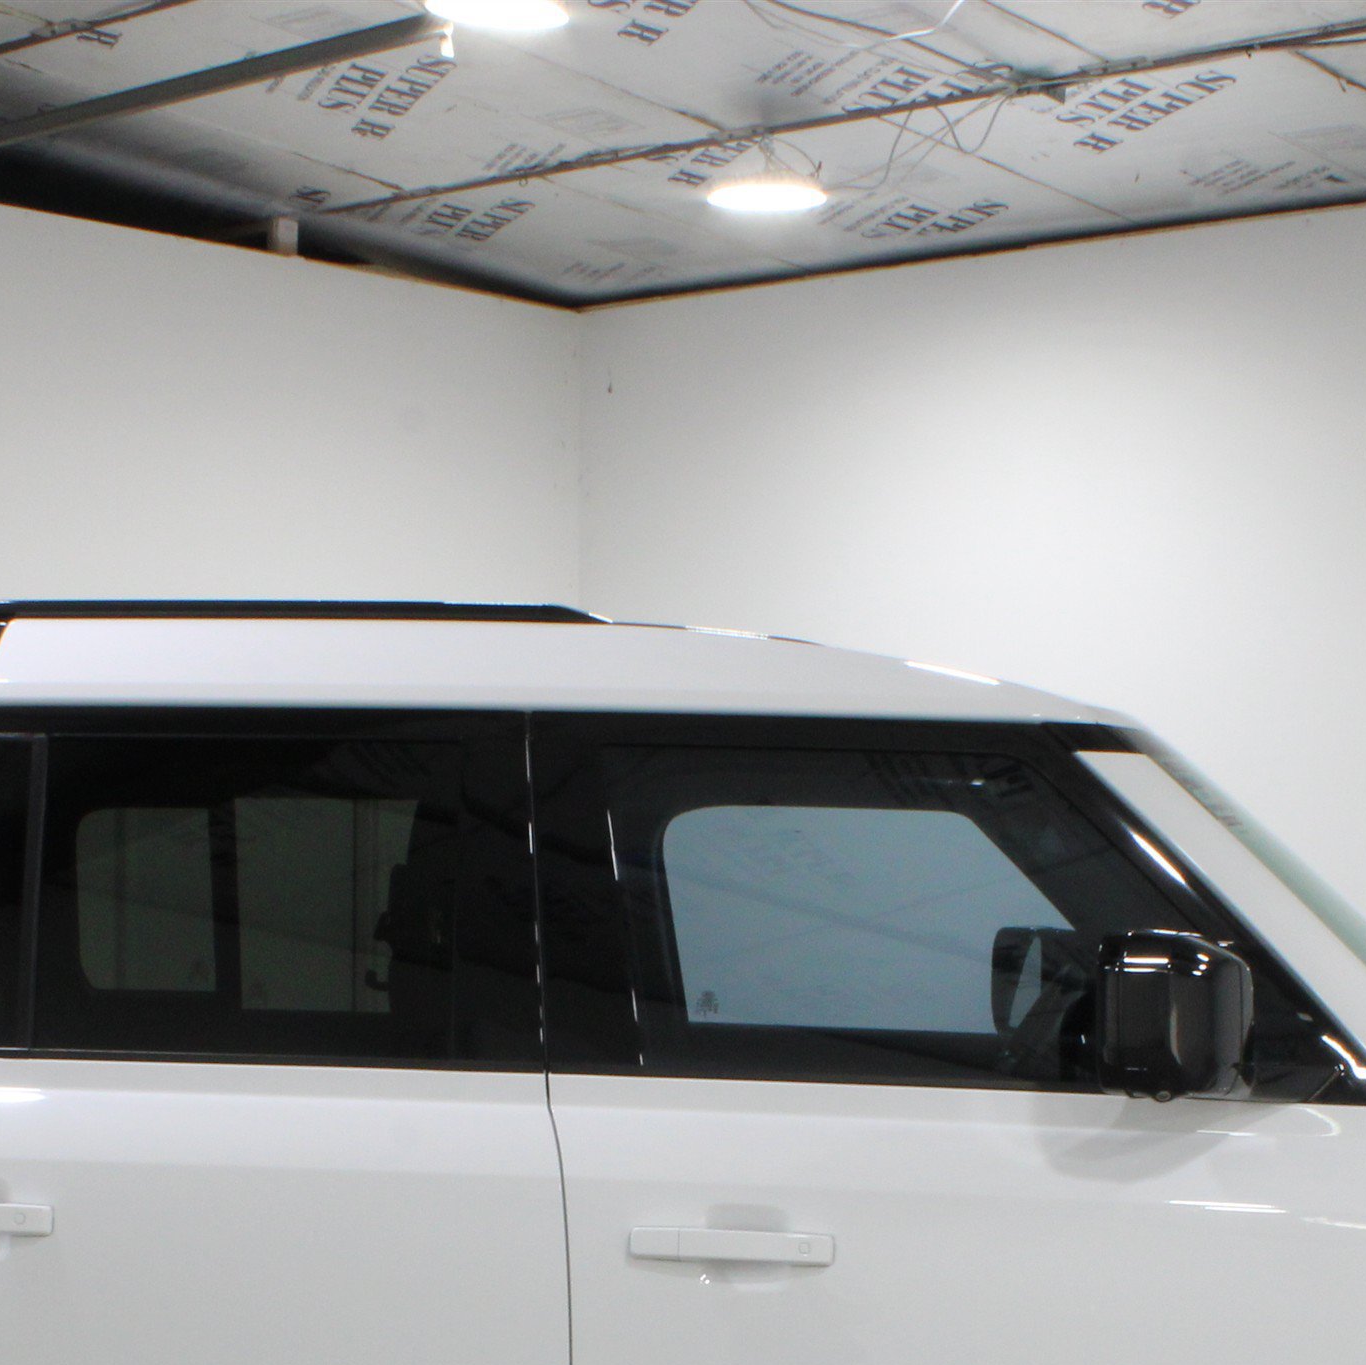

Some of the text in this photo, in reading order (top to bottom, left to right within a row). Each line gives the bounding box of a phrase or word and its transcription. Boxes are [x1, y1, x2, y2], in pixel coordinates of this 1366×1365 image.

[368, 55, 457, 117] SUPER
[1056, 77, 1157, 127] PLUS
[1107, 70, 1236, 131] SUPER
